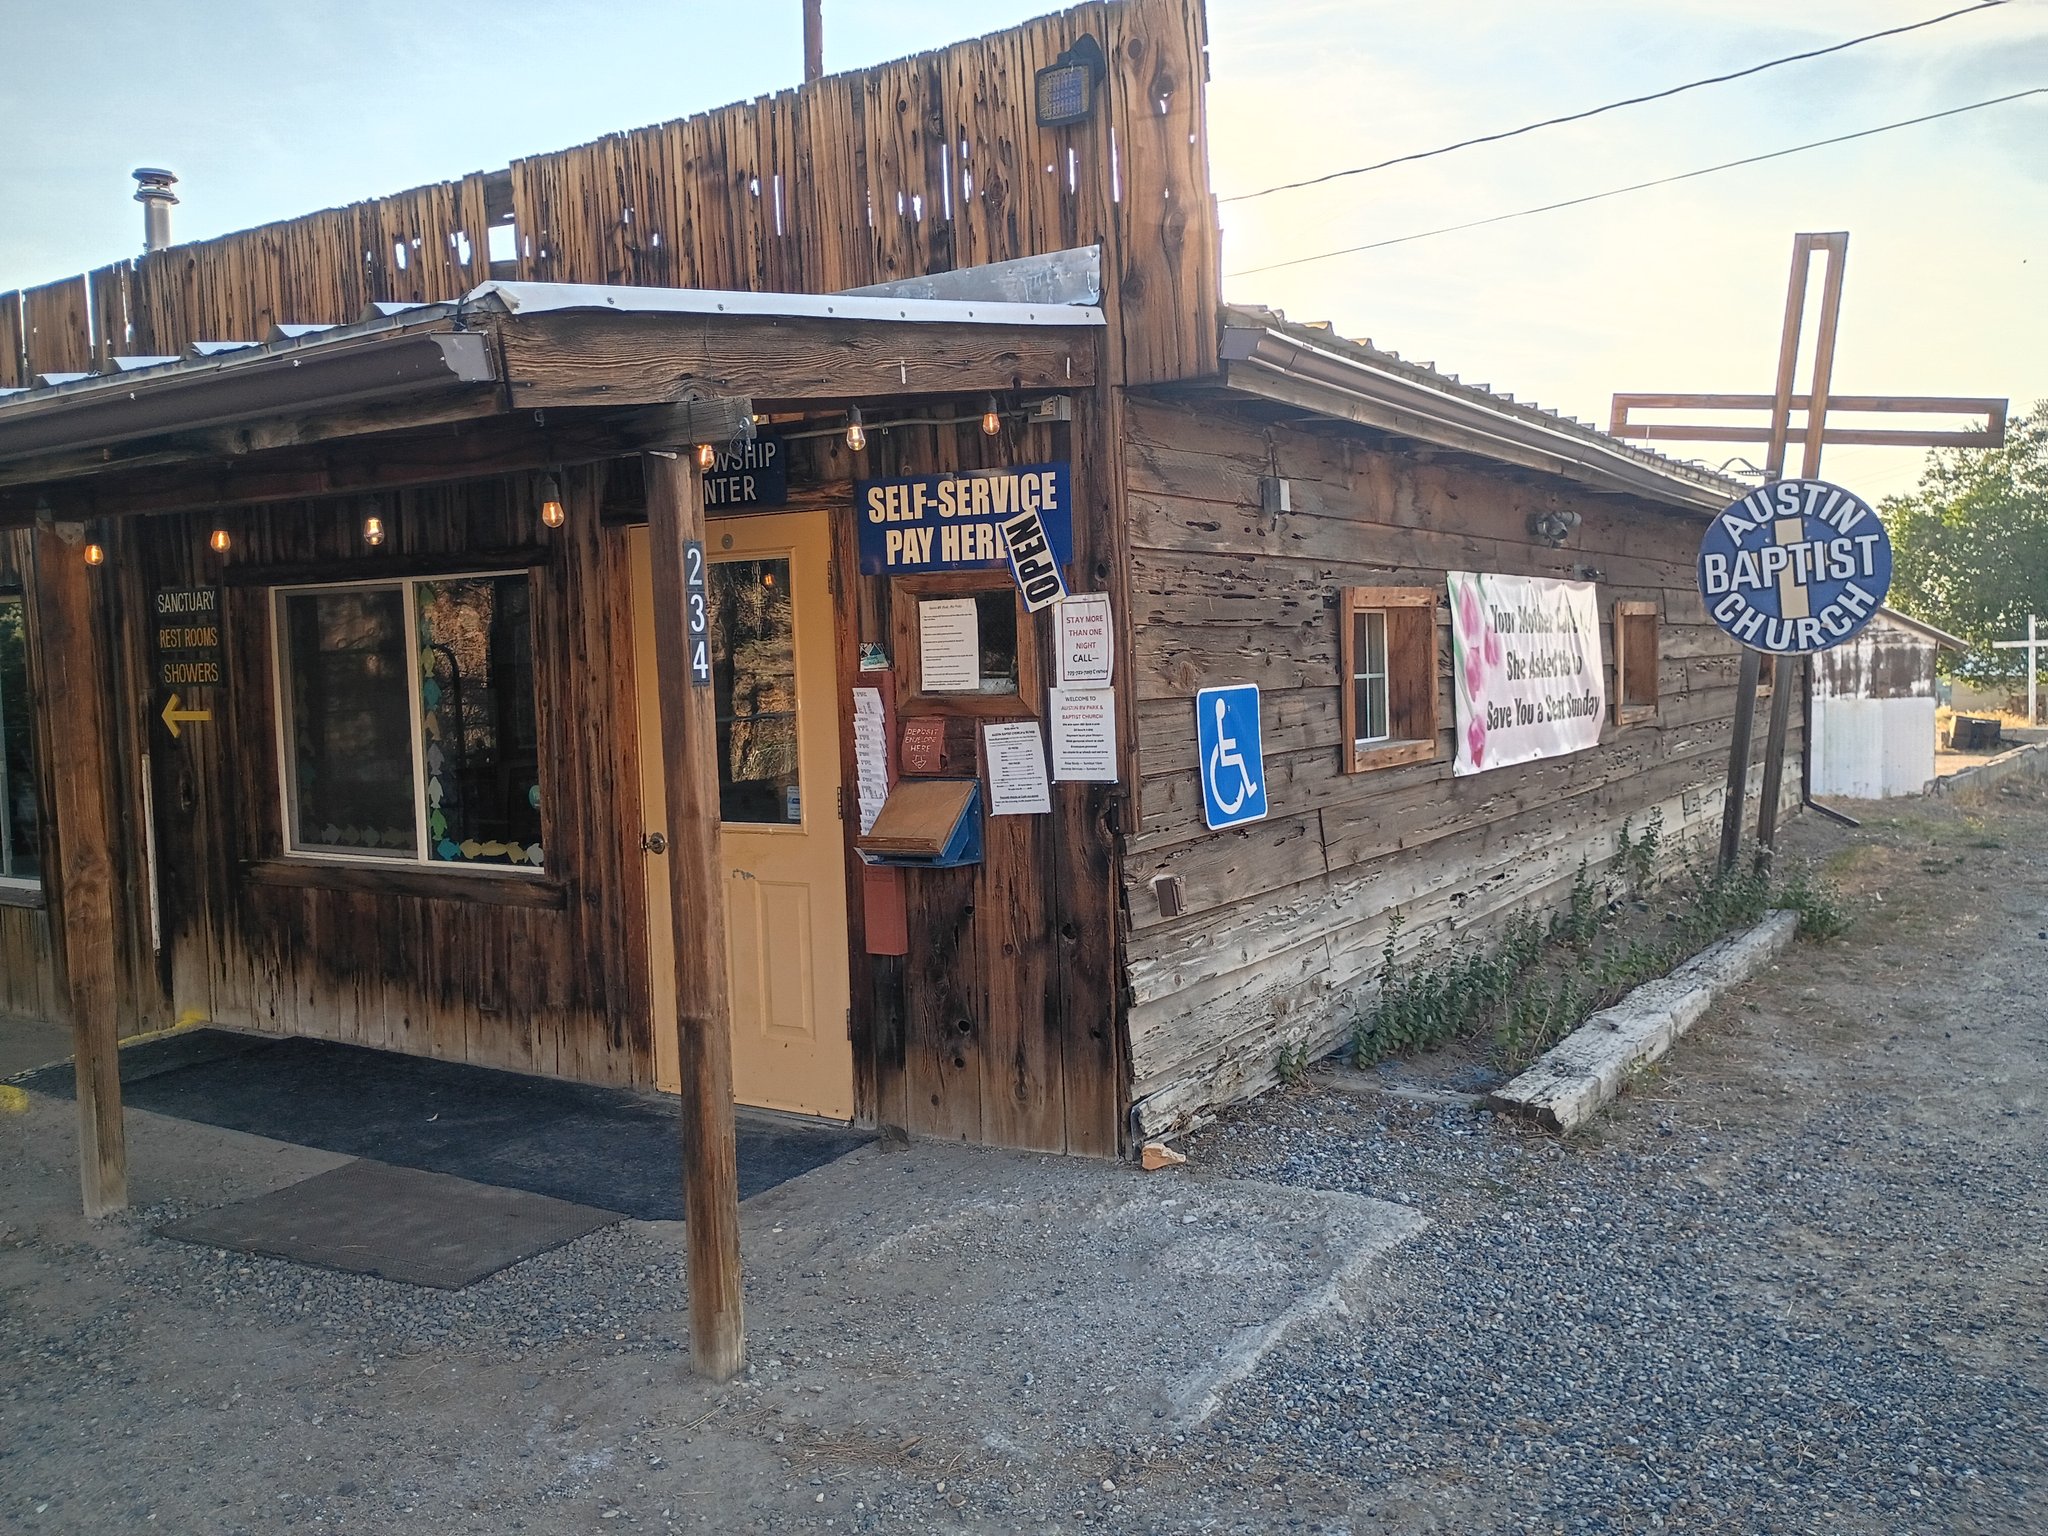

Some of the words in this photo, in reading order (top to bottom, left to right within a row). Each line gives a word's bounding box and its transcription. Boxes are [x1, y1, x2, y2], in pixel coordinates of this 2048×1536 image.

[701, 442, 776, 473] WSHIP
[704, 475, 757, 505] NTER
[867, 471, 1058, 524] SELF-SERVICE
[1721, 483, 1867, 547] AUSTIN
[886, 527, 934, 566] PAY
[1006, 515, 1061, 604] OPEN
[1704, 534, 1880, 594] BAPTIST
[157, 590, 215, 613] SANCTUARY
[687, 547, 709, 679] 234
[1713, 581, 1876, 650] CHURCH
[1066, 616, 1084, 624] STAY
[1490, 604, 1516, 634] Your
[159, 628, 182, 648] REST
[184, 627, 218, 647] ROOMS
[164, 662, 219, 683] SHOWERS
[1506, 651, 1526, 681] She
[1486, 700, 1512, 731] Save
[1514, 698, 1534, 726] You
[1537, 702, 1544, 724] a
[1566, 689, 1600, 722] Sunday
[907, 728, 939, 736] DEPOSIT
[910, 744, 931, 752] HERE
